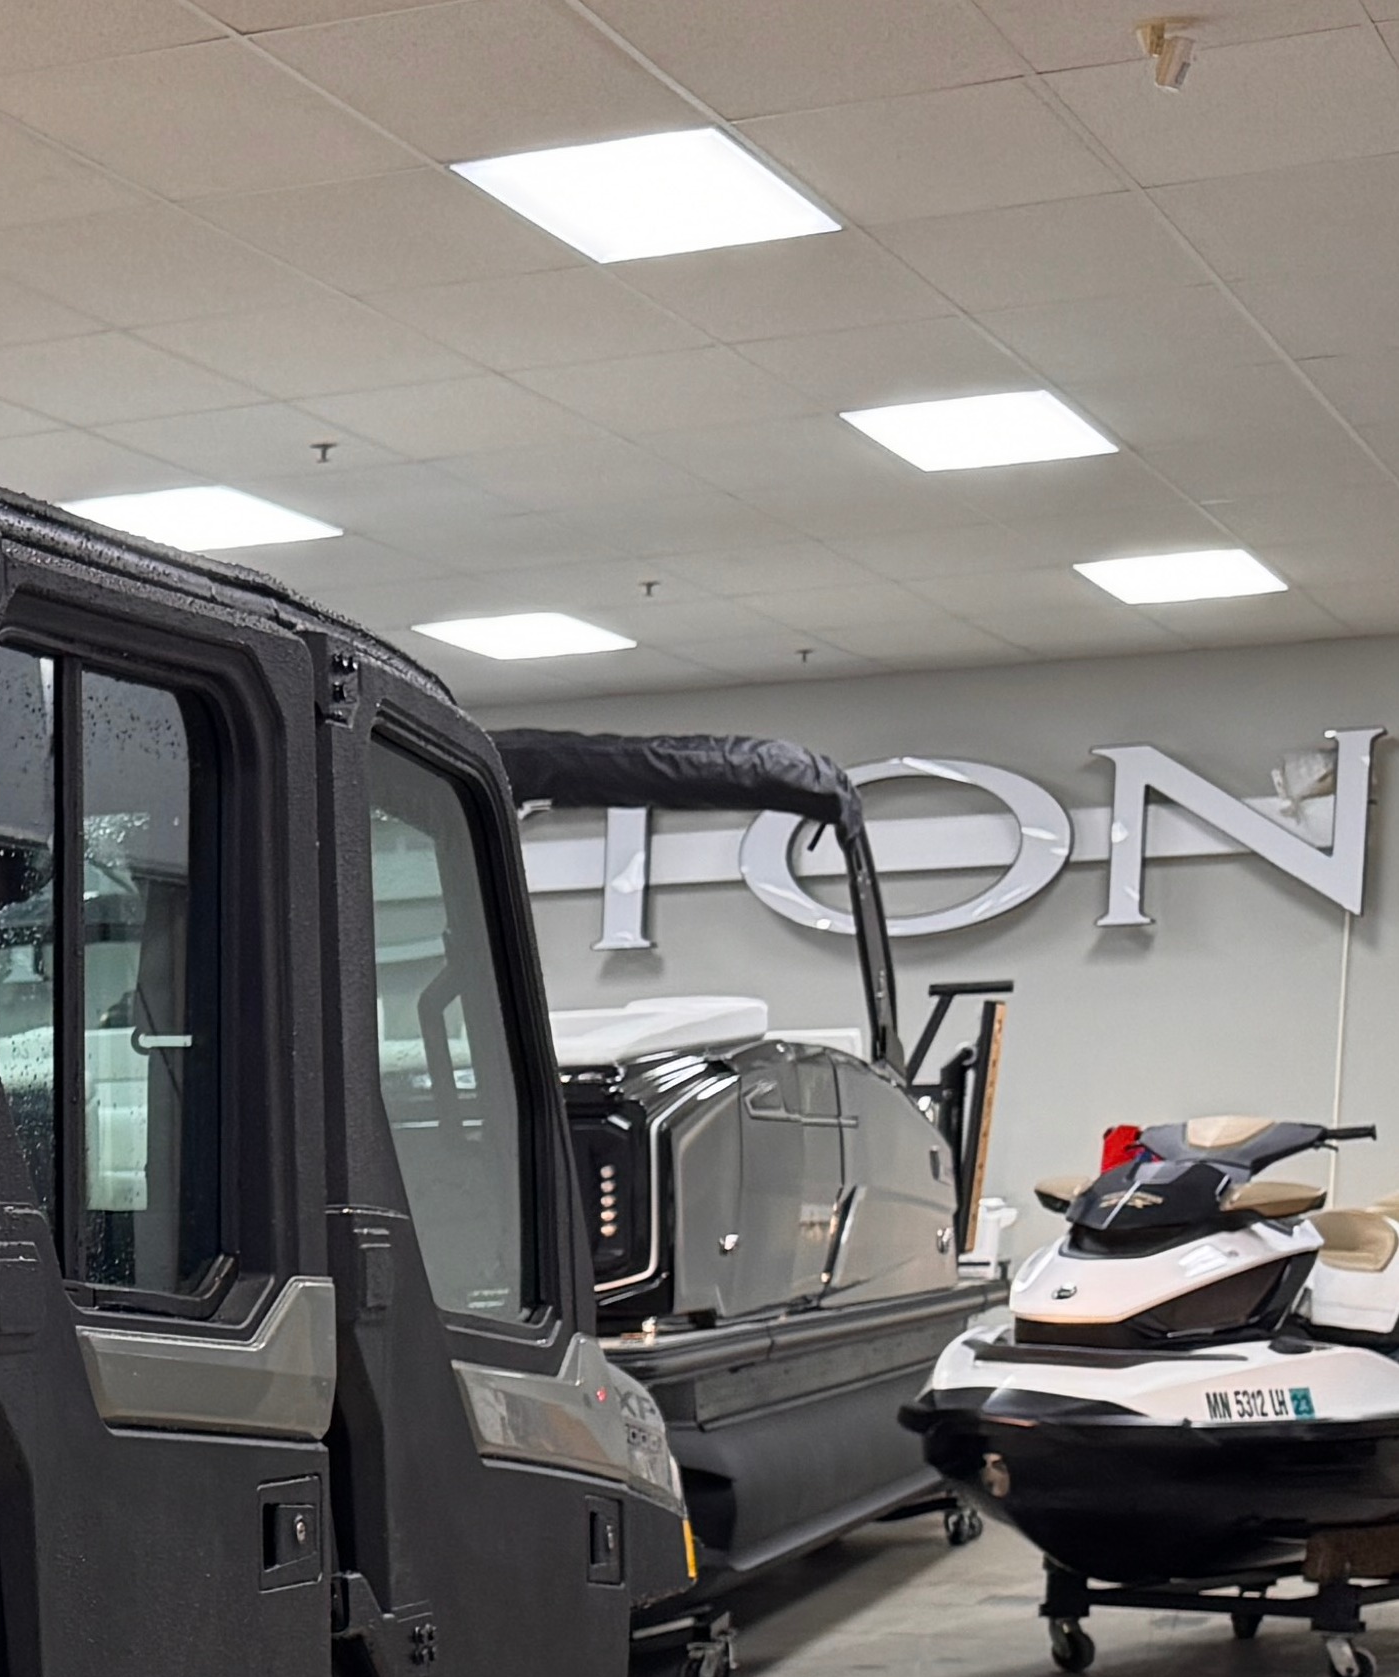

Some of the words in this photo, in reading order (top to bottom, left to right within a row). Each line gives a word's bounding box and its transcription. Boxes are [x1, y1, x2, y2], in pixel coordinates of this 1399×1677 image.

[613, 1386, 657, 1420] XP
[1205, 1391, 1232, 1419] MN
[1234, 1389, 1268, 1418] 5312
[1269, 1388, 1289, 1416] LH
